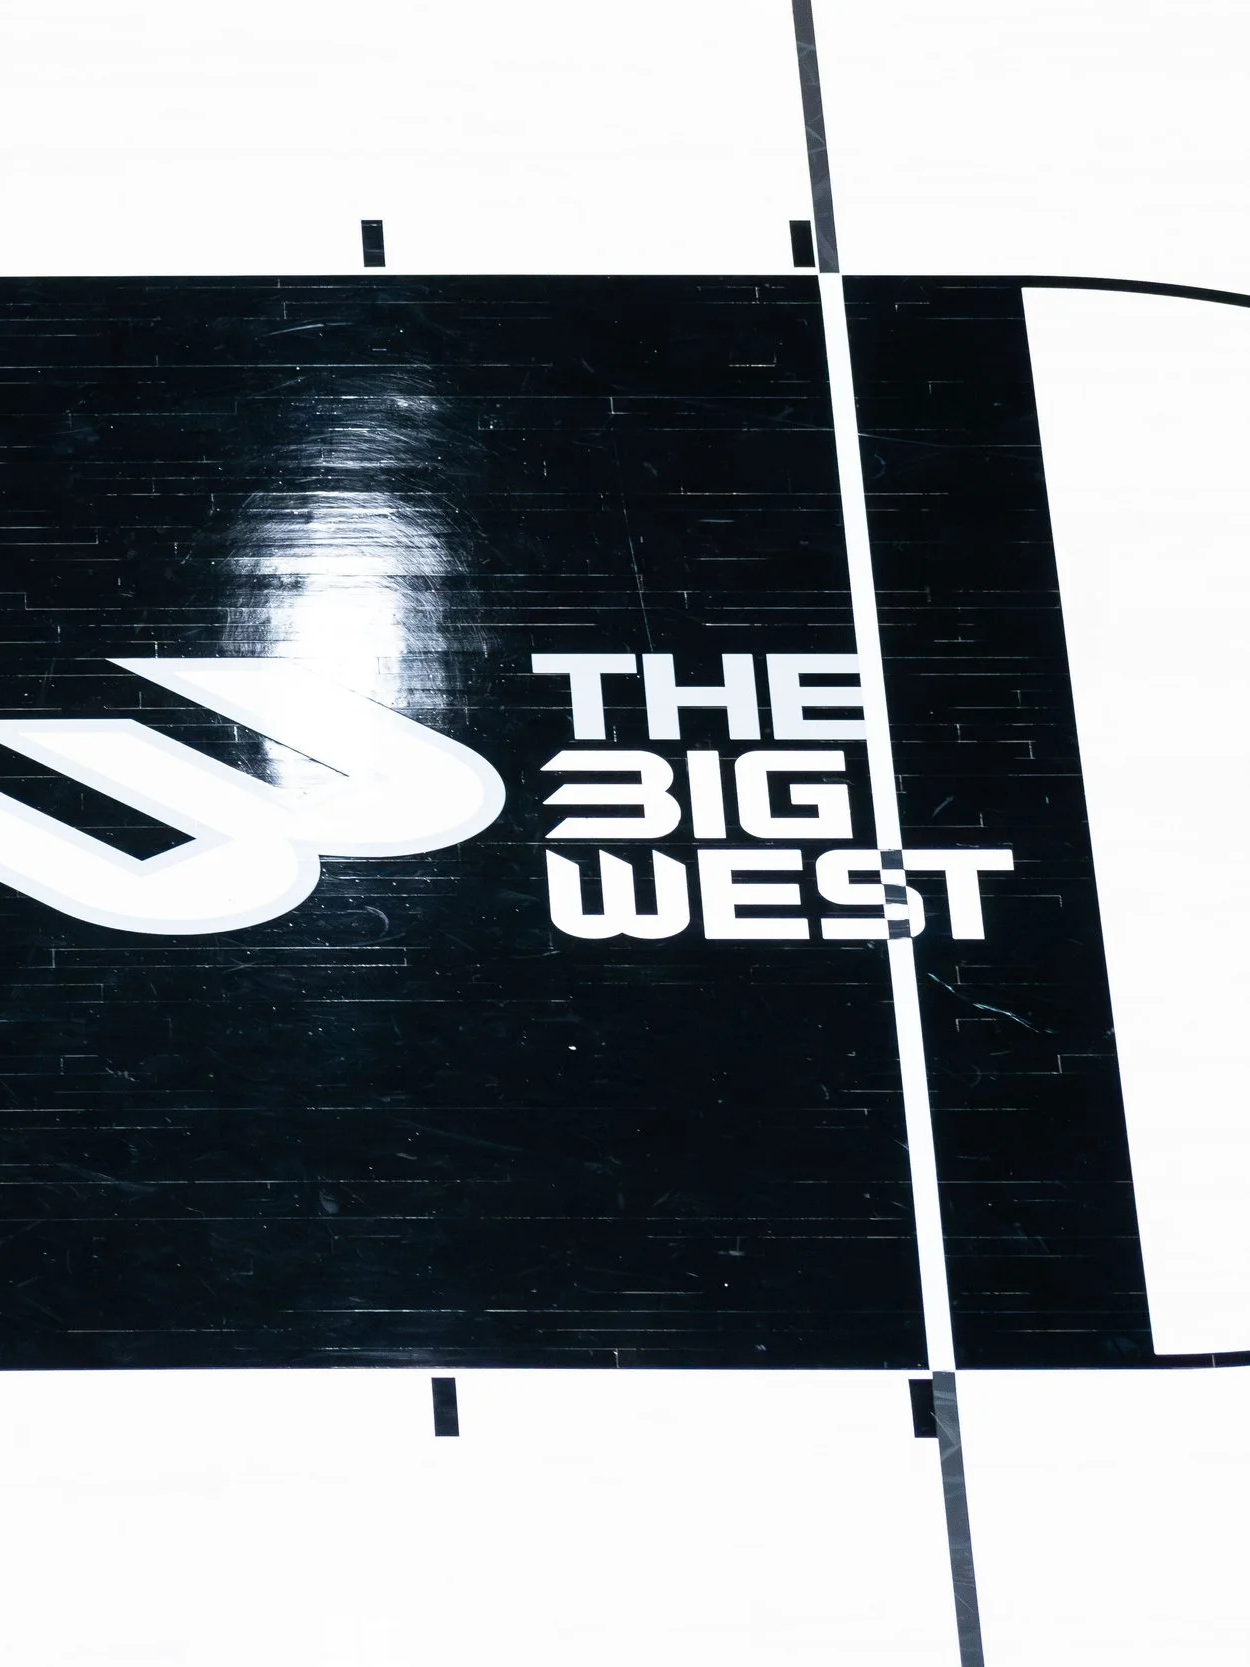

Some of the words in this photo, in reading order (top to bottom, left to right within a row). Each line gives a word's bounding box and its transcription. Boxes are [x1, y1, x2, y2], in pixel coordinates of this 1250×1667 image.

[531, 653, 867, 740] THE
[539, 750, 853, 839] BIG
[546, 849, 1014, 940] WEST
